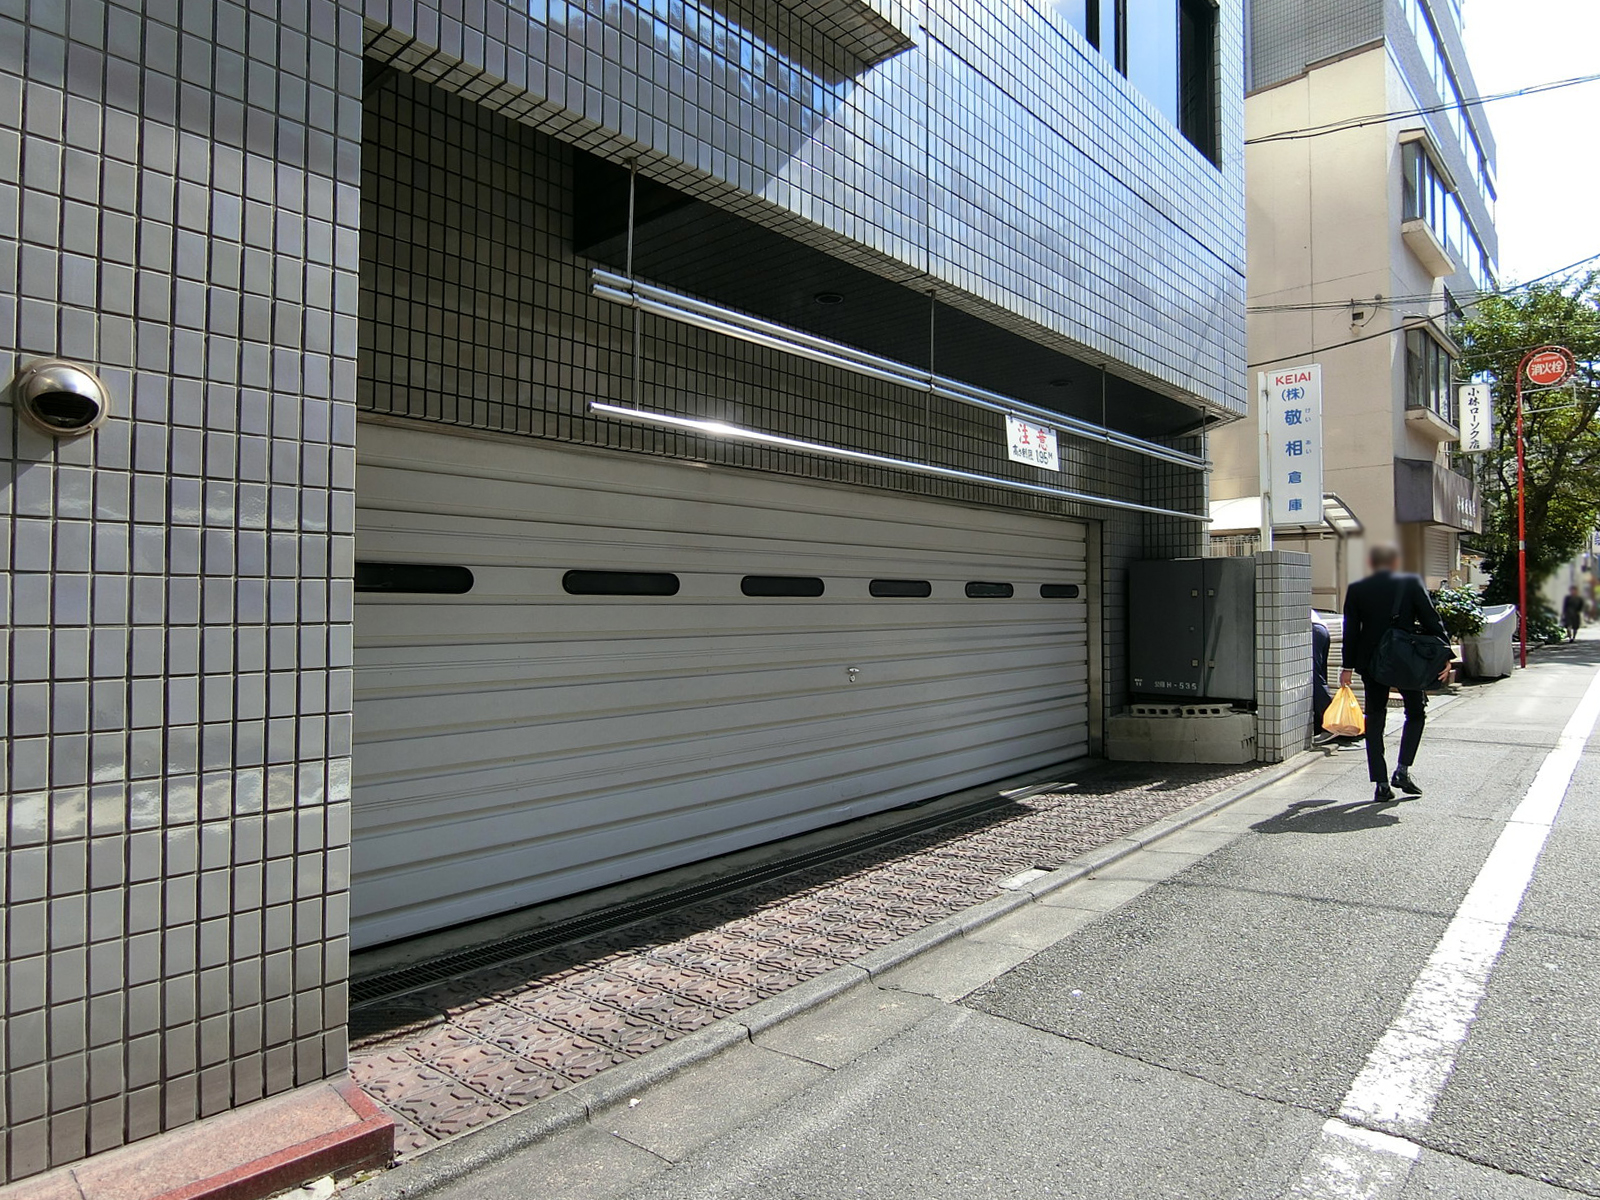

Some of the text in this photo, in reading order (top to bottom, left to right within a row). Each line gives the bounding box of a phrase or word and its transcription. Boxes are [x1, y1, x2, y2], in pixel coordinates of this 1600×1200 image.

[1275, 371, 1311, 386] KEIAI
[1531, 360, 1564, 377] 消火栓
[1281, 386, 1305, 402] (株)
[1467, 387, 1480, 450] 小林ローソク店
[1018, 424, 1047, 451] 注意
[1284, 408, 1303, 512] 敬相倉庫
